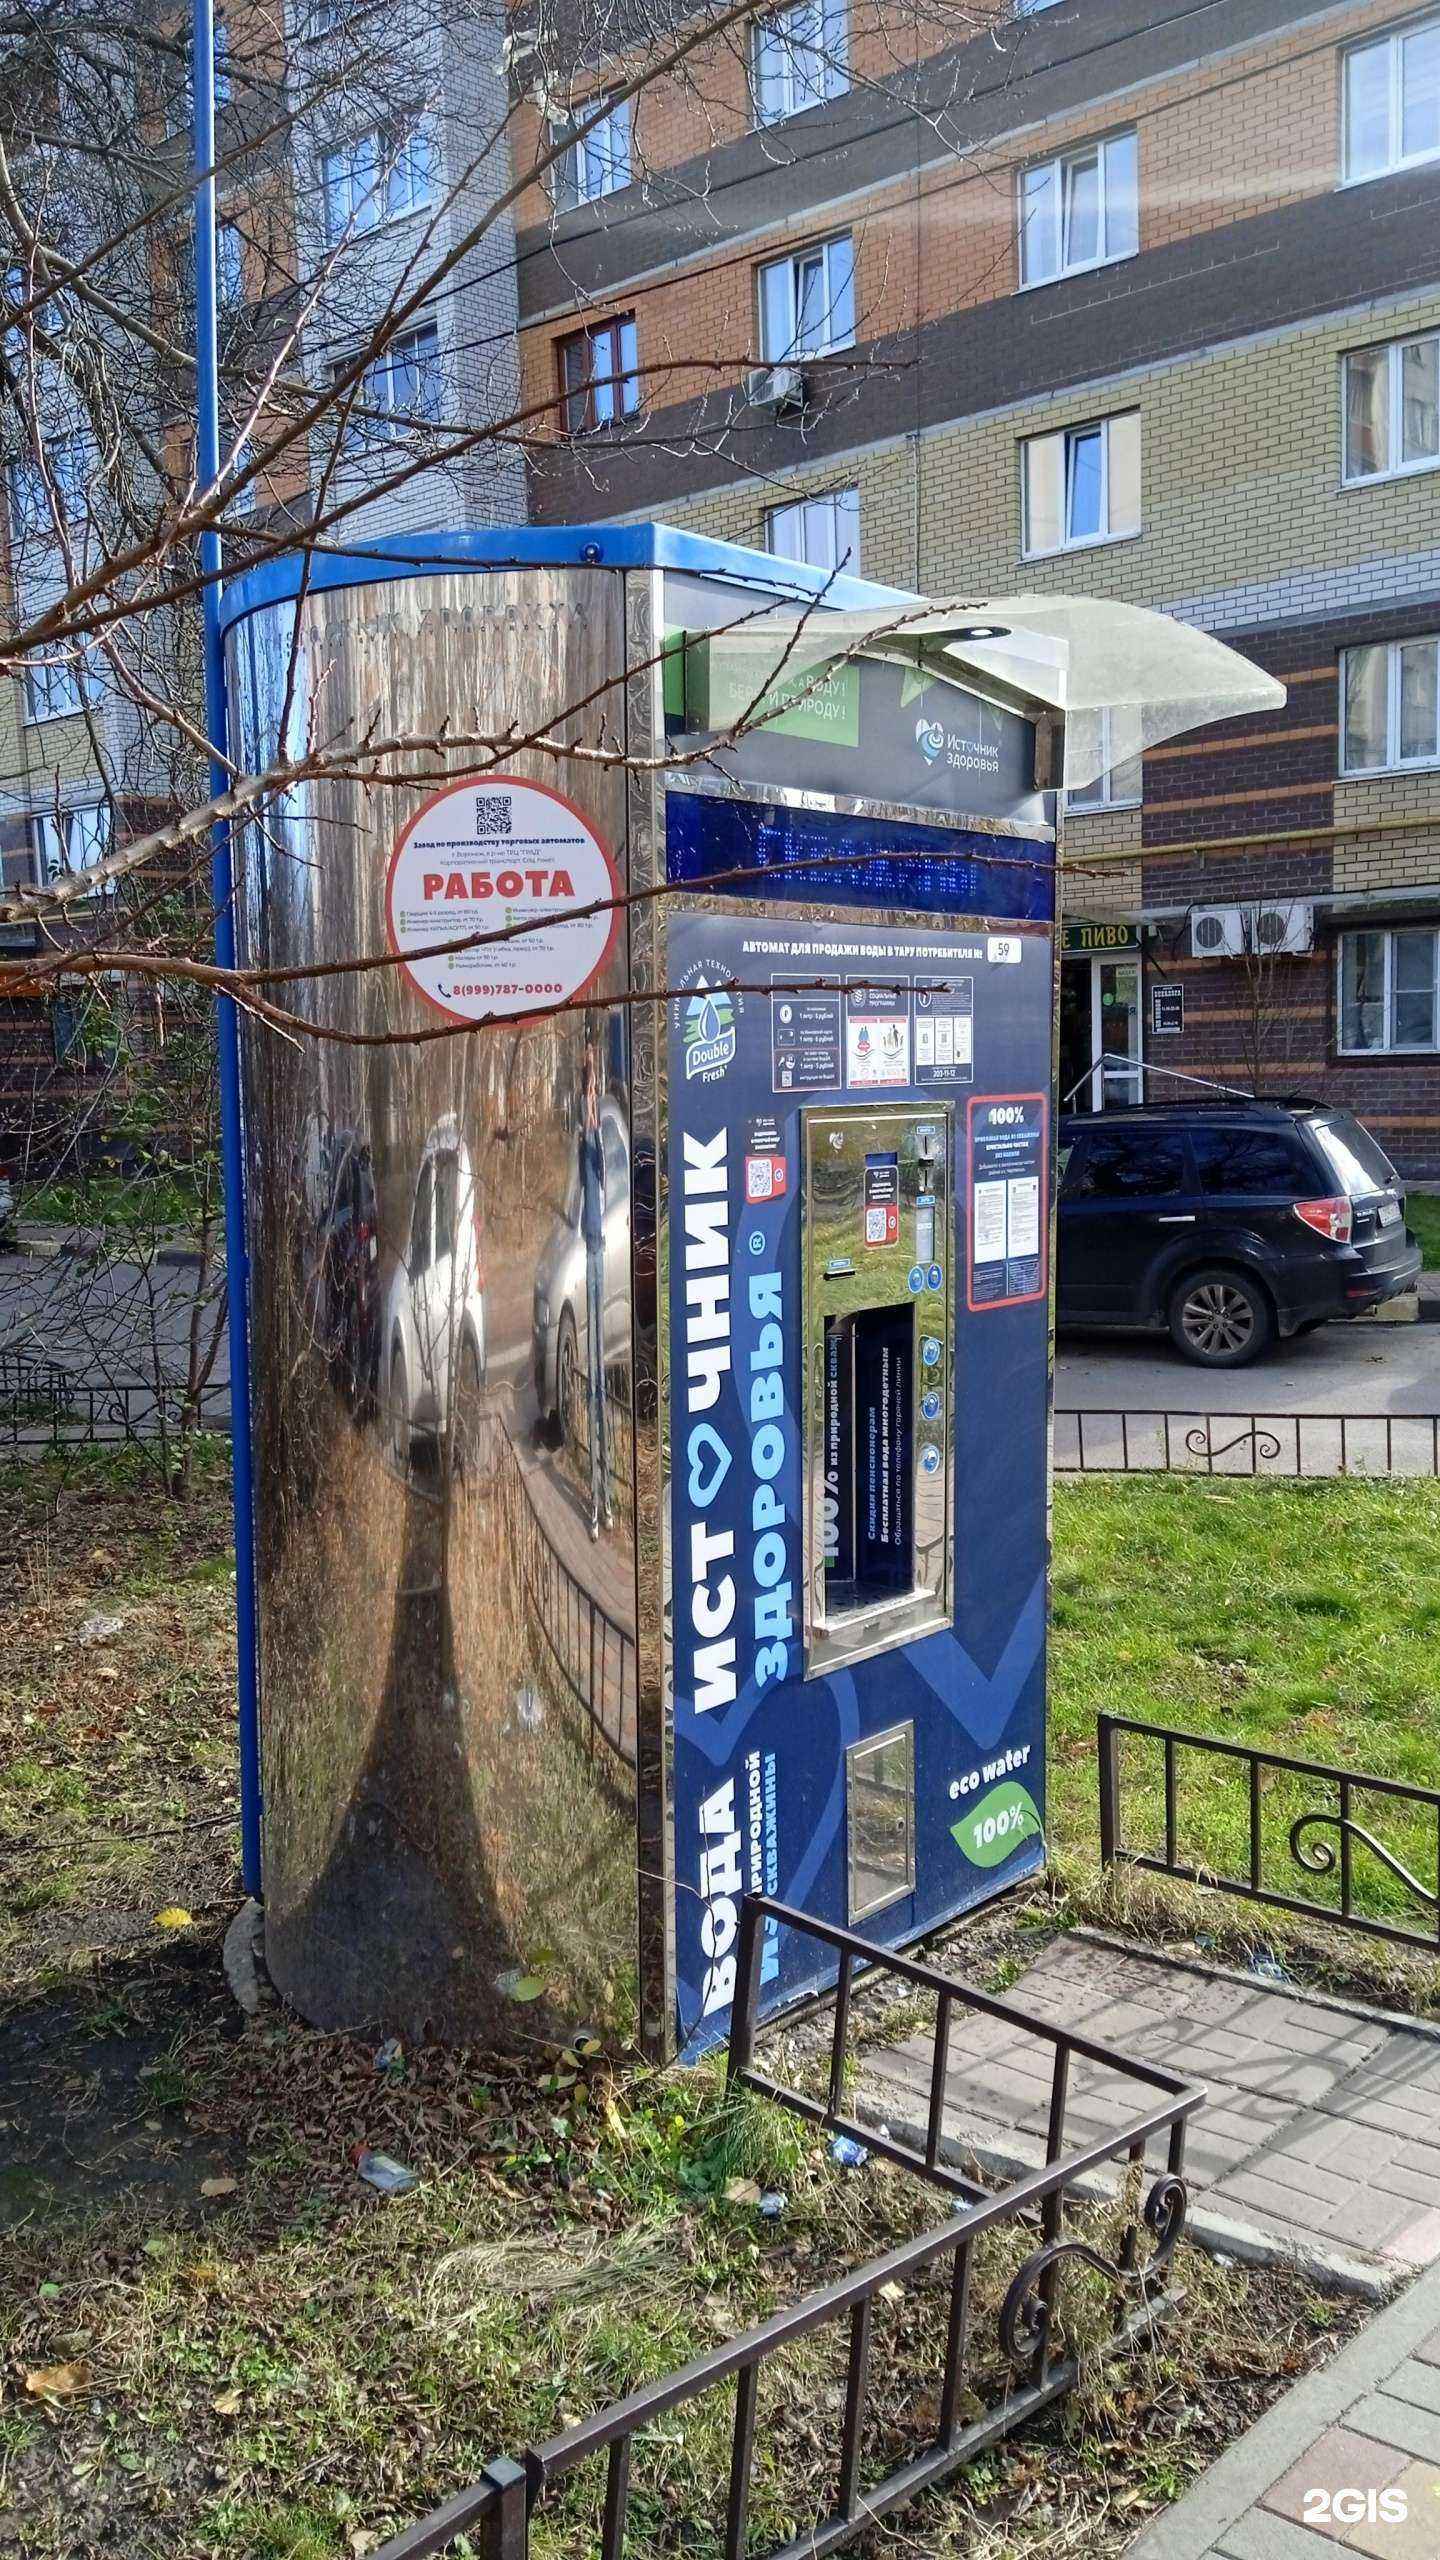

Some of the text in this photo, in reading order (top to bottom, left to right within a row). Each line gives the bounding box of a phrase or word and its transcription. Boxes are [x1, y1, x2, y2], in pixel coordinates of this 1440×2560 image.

[423, 870, 576, 900] РАБОТА
[742, 940, 790, 954] АВТОМАТ
[790, 942, 811, 956] ДЛЯ
[812, 943, 859, 957] ПРОДАЖИ
[860, 945, 887, 958] ВОДЫ
[887, 946, 894, 957] В
[894, 946, 915, 958] ТАРУ
[915, 947, 974, 959] ПОТРЕБИТЕЛЯ
[1080, 925, 1129, 948] ПИВО
[453, 983, 563, 996] 8(999)787-0000
[693, 1040, 729, 1066] Double
[702, 1065, 725, 1083] Fresh
[990, 1106, 1025, 1125] 100%
[827, 1380, 842, 1450] природной
[880, 1347, 891, 1543] Бесплатная вода многодетным
[749, 1271, 793, 1688] ЗДОРОВЬЯ
[867, 1494, 877, 1540] Скидки
[949, 1745, 1031, 1800] eco water
[764, 1752, 779, 1896] СКВАЖИНЫ
[973, 1801, 1024, 1849] 100%
[699, 1776, 743, 2018] ВОДА
